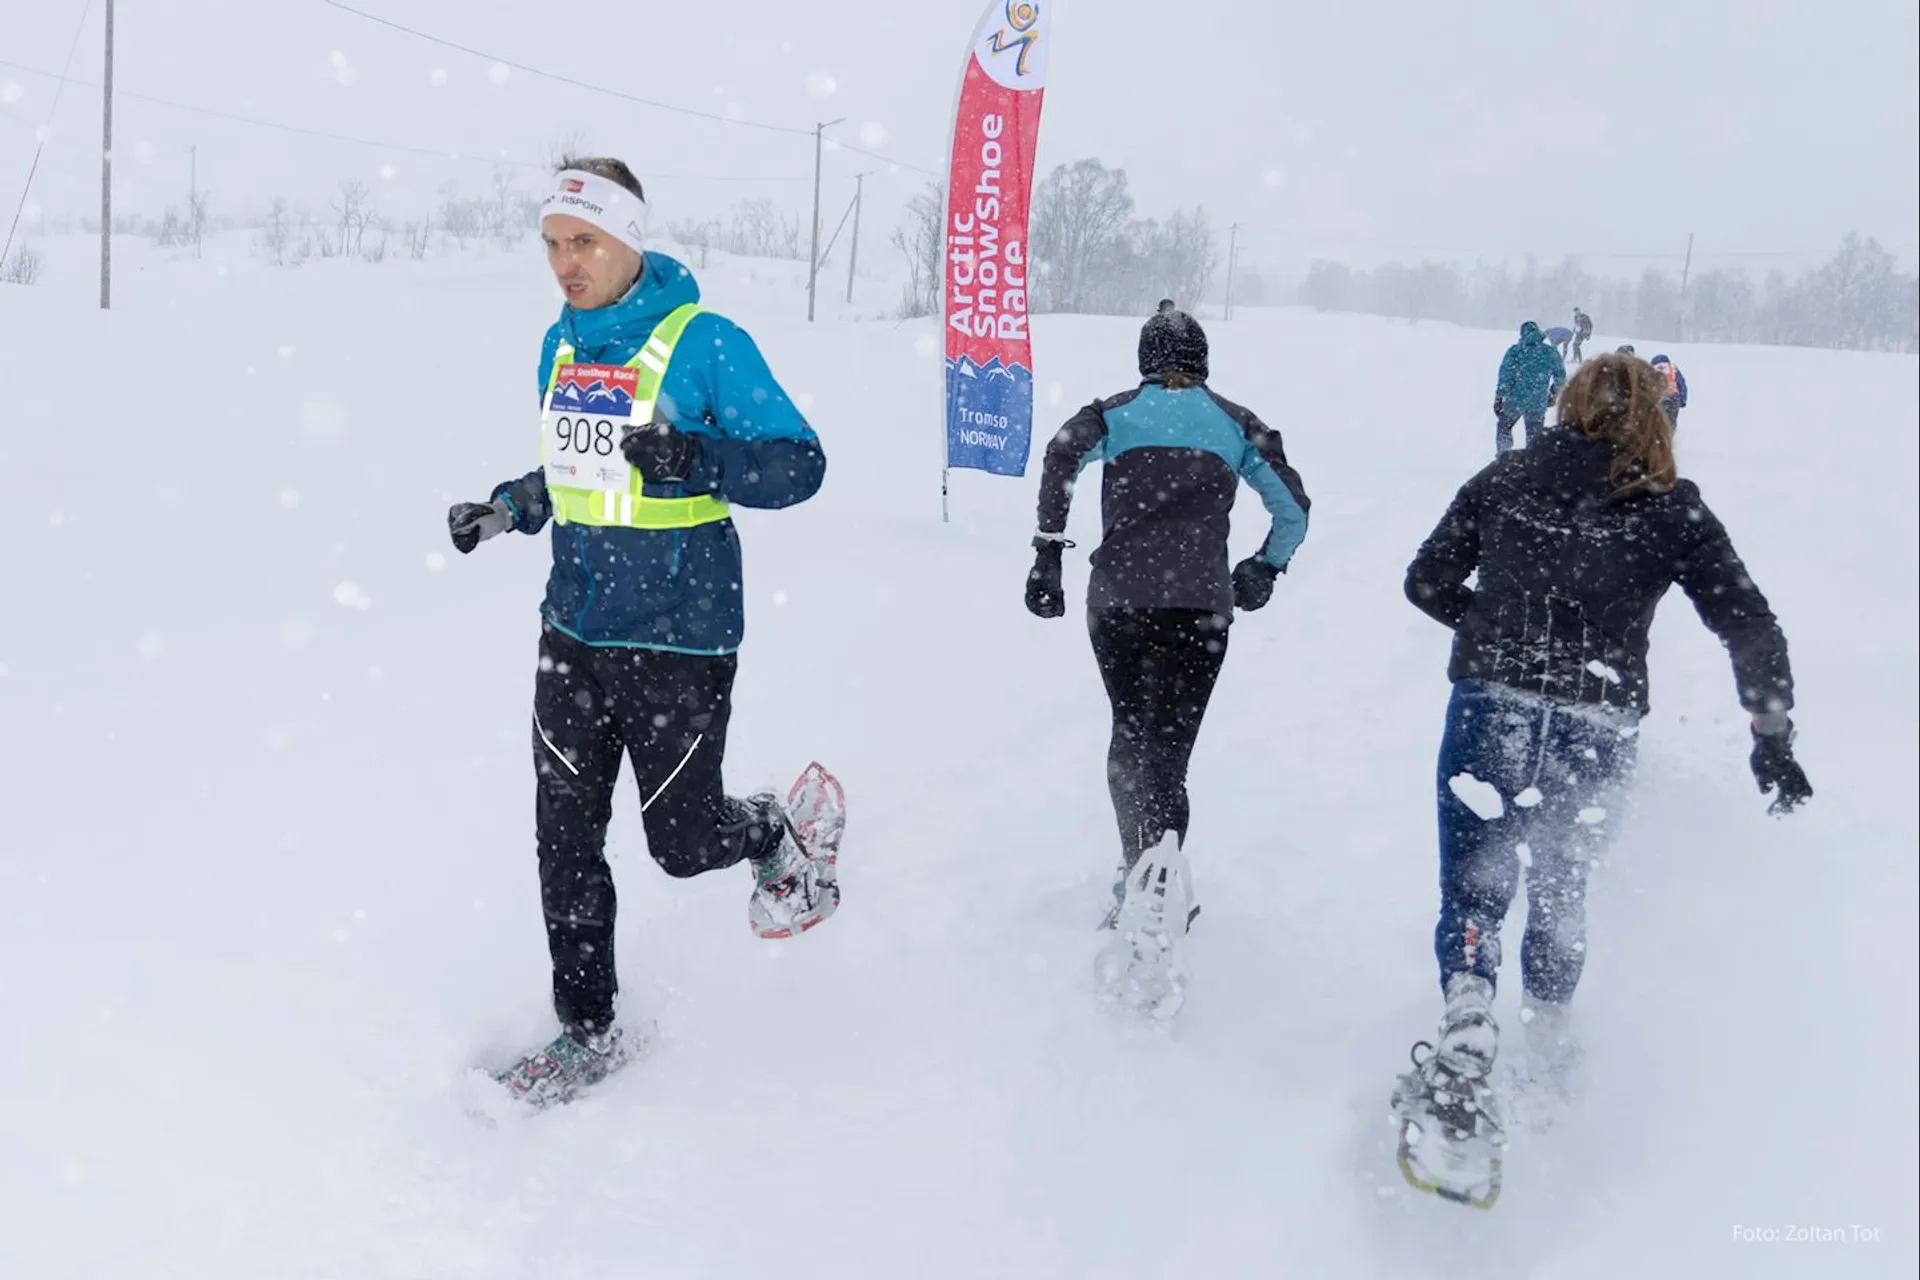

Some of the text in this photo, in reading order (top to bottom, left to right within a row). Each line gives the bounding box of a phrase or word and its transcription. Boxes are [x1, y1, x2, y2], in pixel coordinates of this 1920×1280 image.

[949, 212, 975, 338] Arctic
[997, 240, 1027, 341] Race
[556, 416, 613, 456] 908
[959, 407, 1008, 429] Tromsø
[960, 429, 1008, 451] NORWAY
